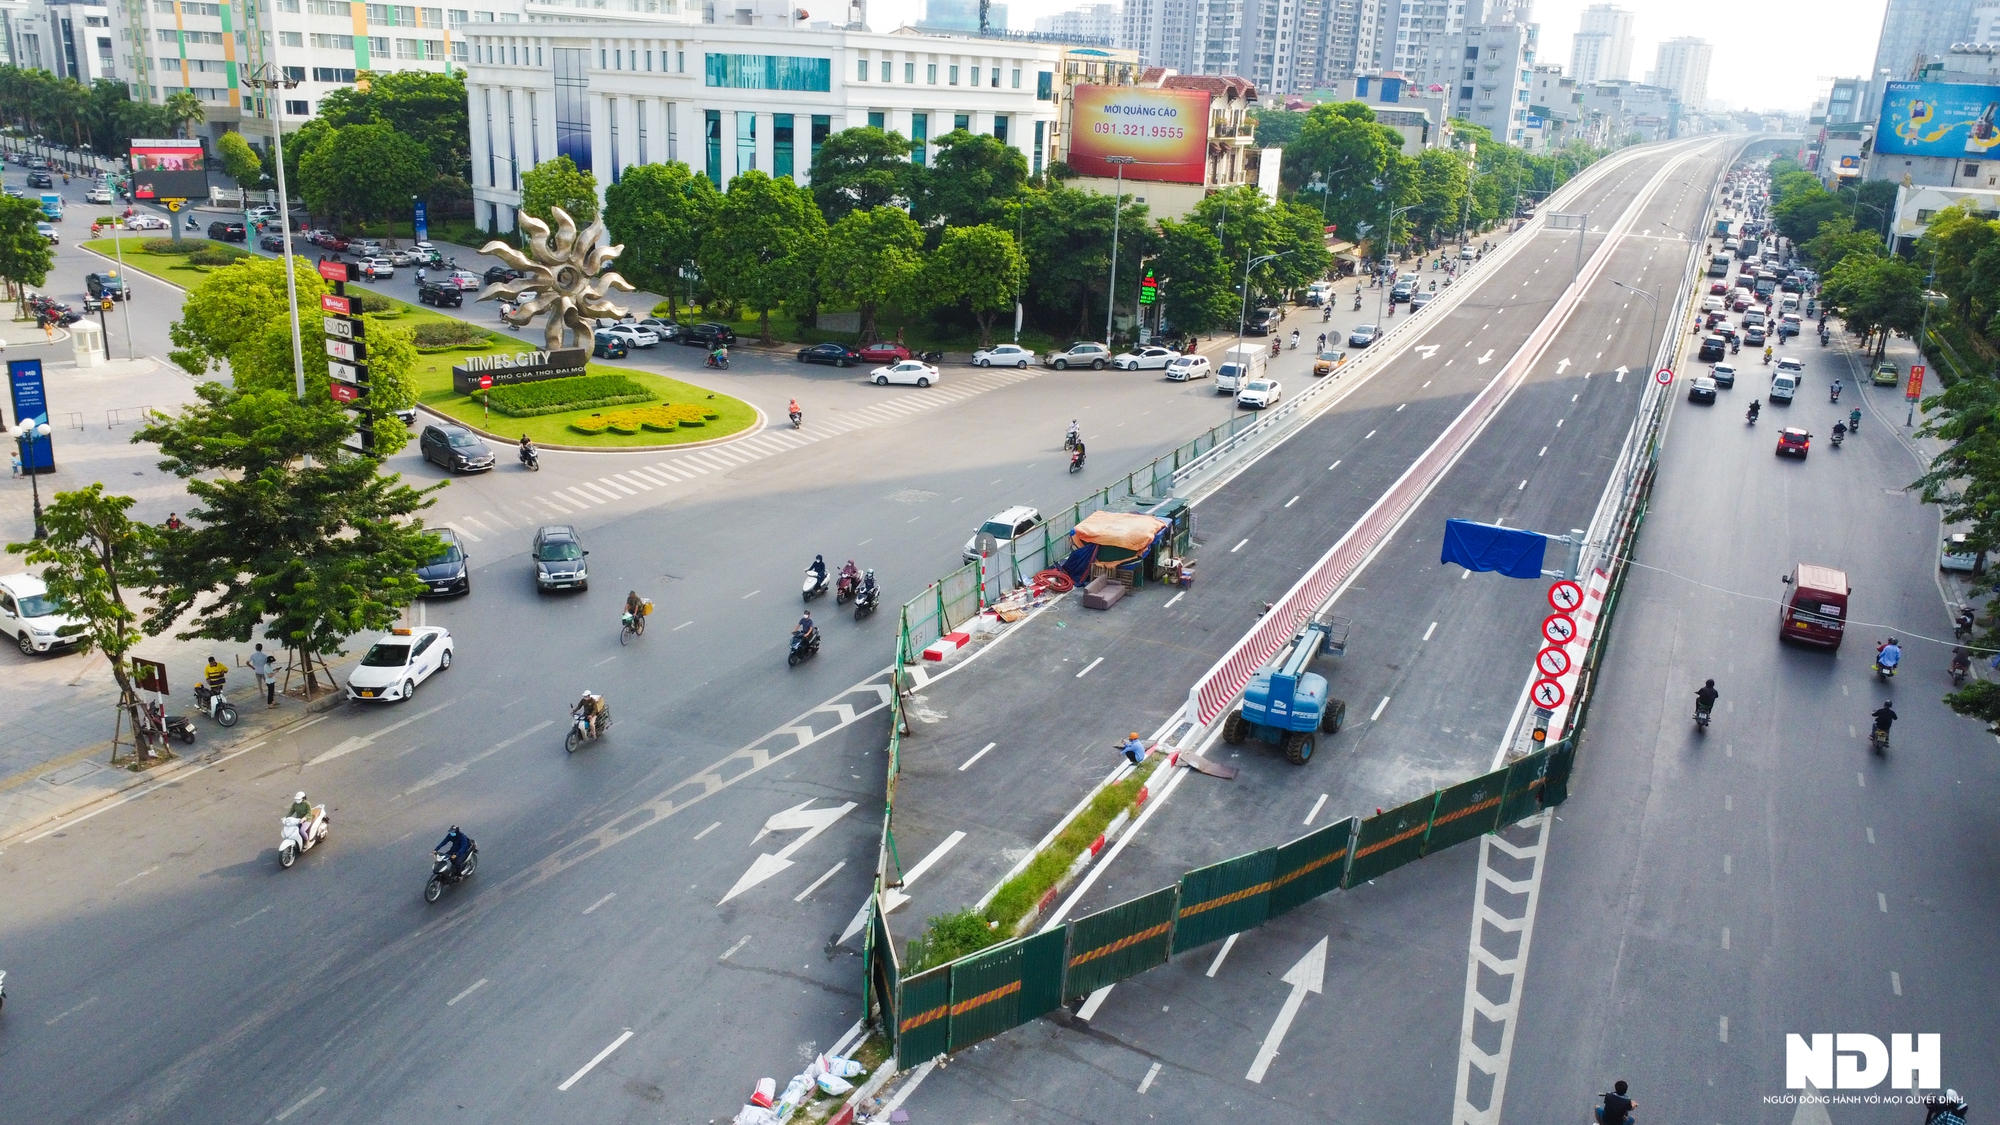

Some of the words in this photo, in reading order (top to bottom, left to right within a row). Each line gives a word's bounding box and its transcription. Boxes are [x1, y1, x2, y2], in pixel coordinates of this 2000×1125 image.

[1104, 104, 1121, 114] MỜI
[1123, 104, 1156, 116] QUẢNG
[1158, 107, 1177, 117] CÁO
[1094, 122, 1184, 139] 091.321.9555
[326, 320, 349, 335] SIXDO
[465, 354, 510, 372] TIMES
[515, 350, 551, 367] CITY
